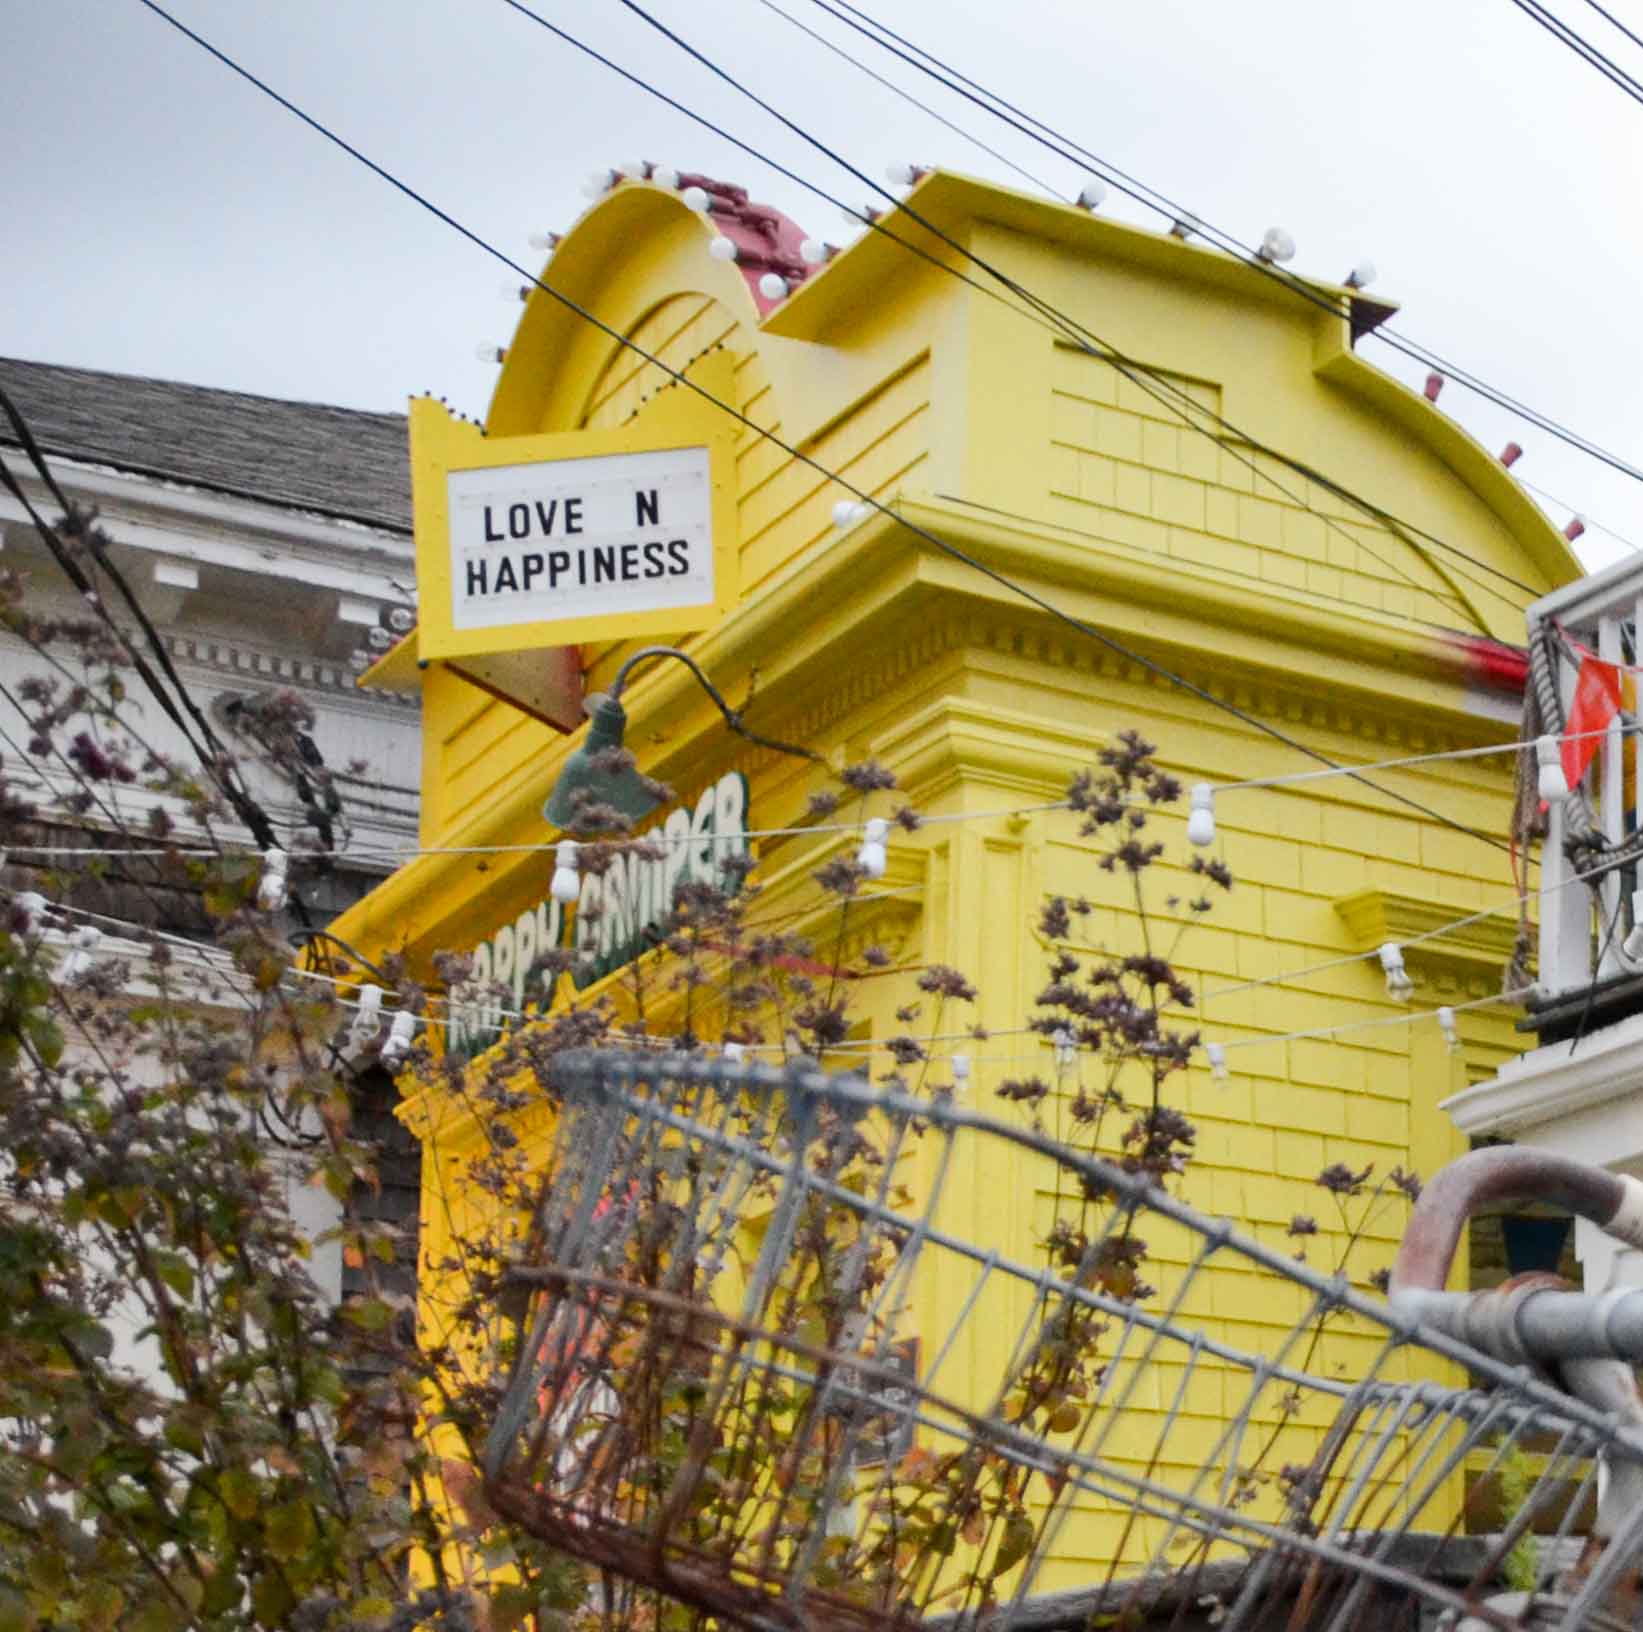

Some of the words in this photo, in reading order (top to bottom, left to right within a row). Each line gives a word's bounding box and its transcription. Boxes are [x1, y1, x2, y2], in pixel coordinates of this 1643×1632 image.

[483, 497, 583, 542] LOVE
[635, 489, 660, 526] N
[466, 539, 690, 597] HAPPINESS
